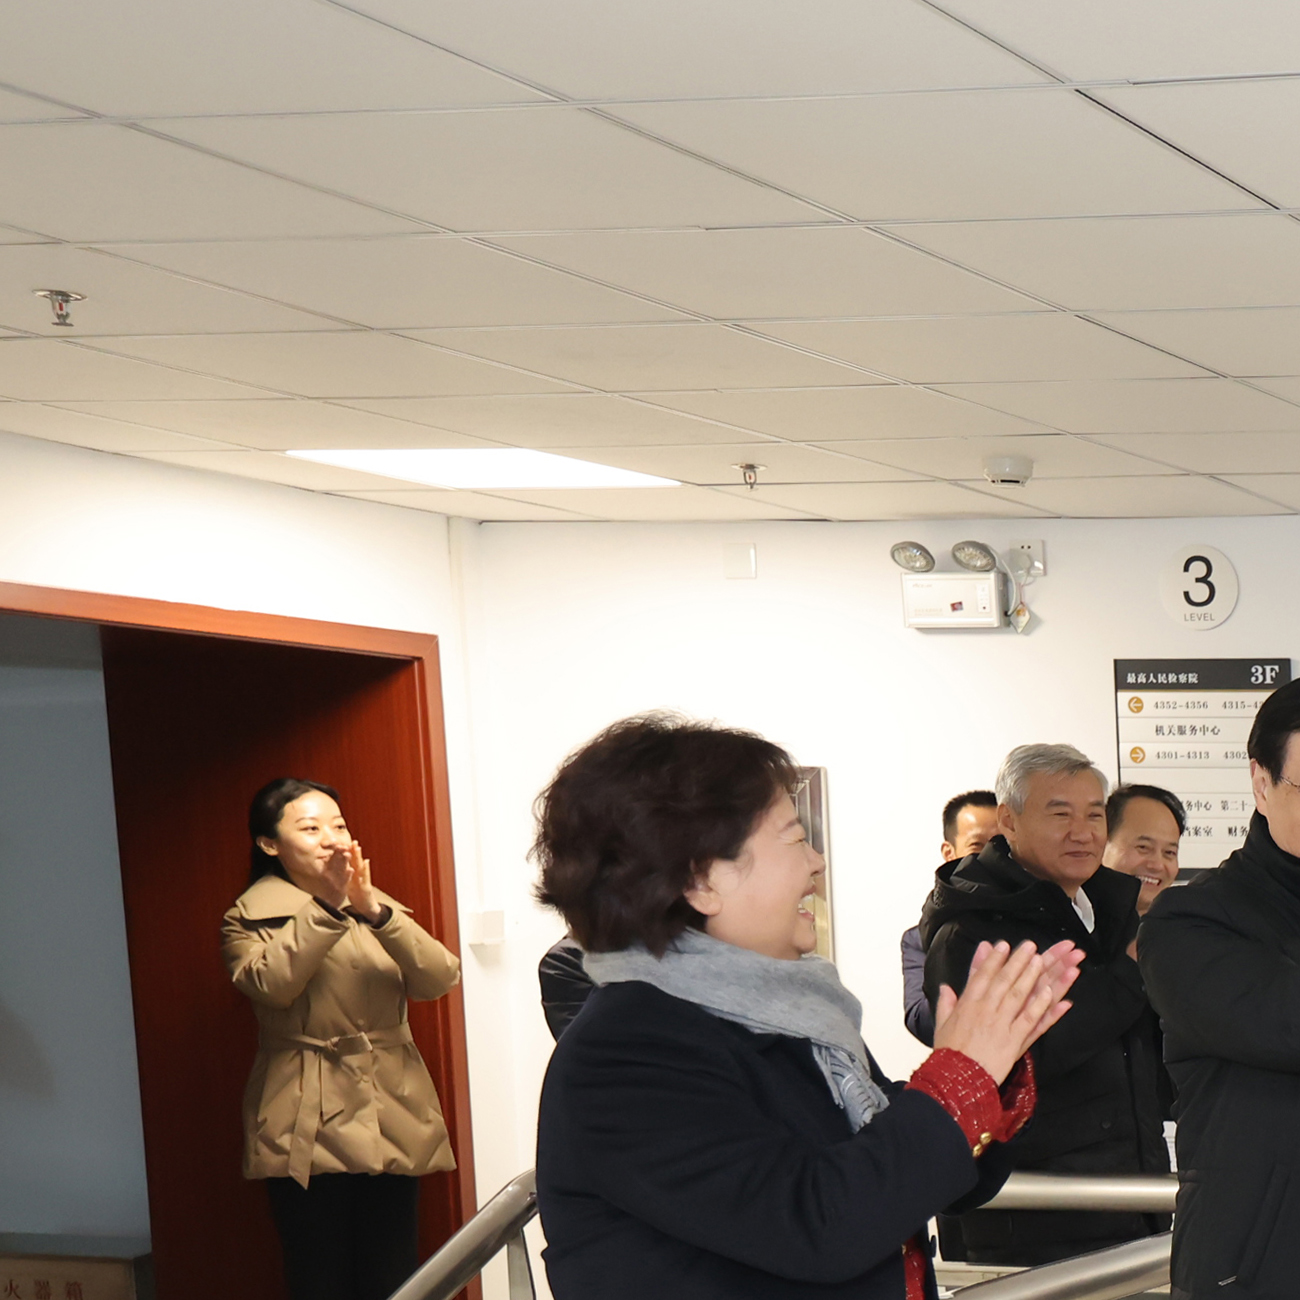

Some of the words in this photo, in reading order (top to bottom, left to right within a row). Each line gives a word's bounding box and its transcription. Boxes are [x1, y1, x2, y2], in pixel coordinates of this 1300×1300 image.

[1183, 555, 1216, 607] 3
[1184, 613, 1215, 622] LEVEL
[1126, 672, 1199, 684] 最高人民检察院
[1250, 665, 1279, 684] 3F
[1153, 701, 1209, 709] 4352-4356
[1155, 725, 1221, 736] 机关服务中心
[1155, 751, 1210, 760] 4301-4313
[1181, 800, 1212, 812] 务中心
